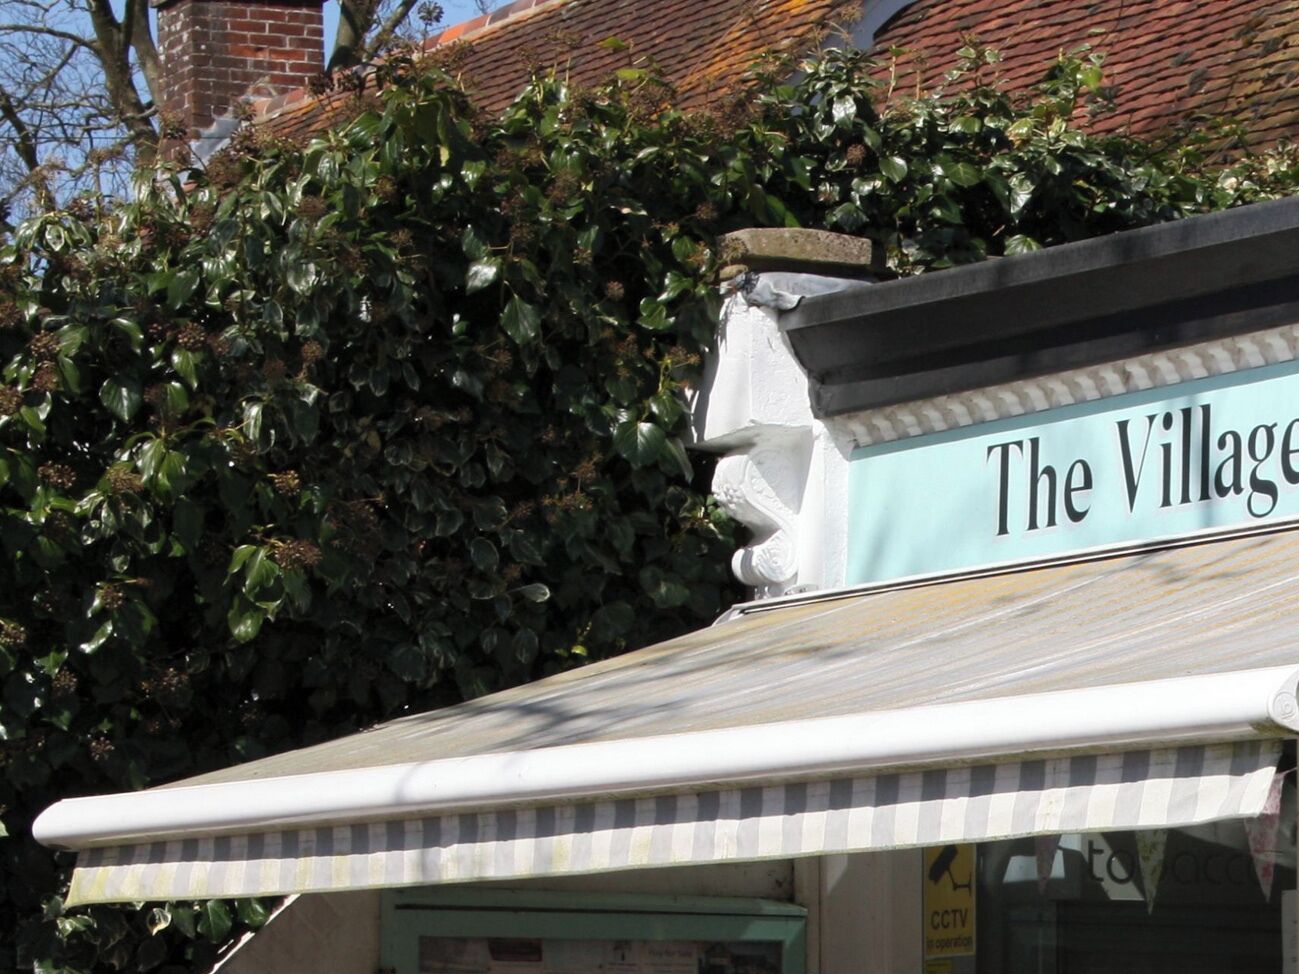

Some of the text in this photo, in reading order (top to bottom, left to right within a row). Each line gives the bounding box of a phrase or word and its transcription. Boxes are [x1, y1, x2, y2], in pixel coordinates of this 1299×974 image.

[986, 437, 1093, 536] The
[930, 907, 969, 931] CCTV
[935, 934, 974, 952] operation
